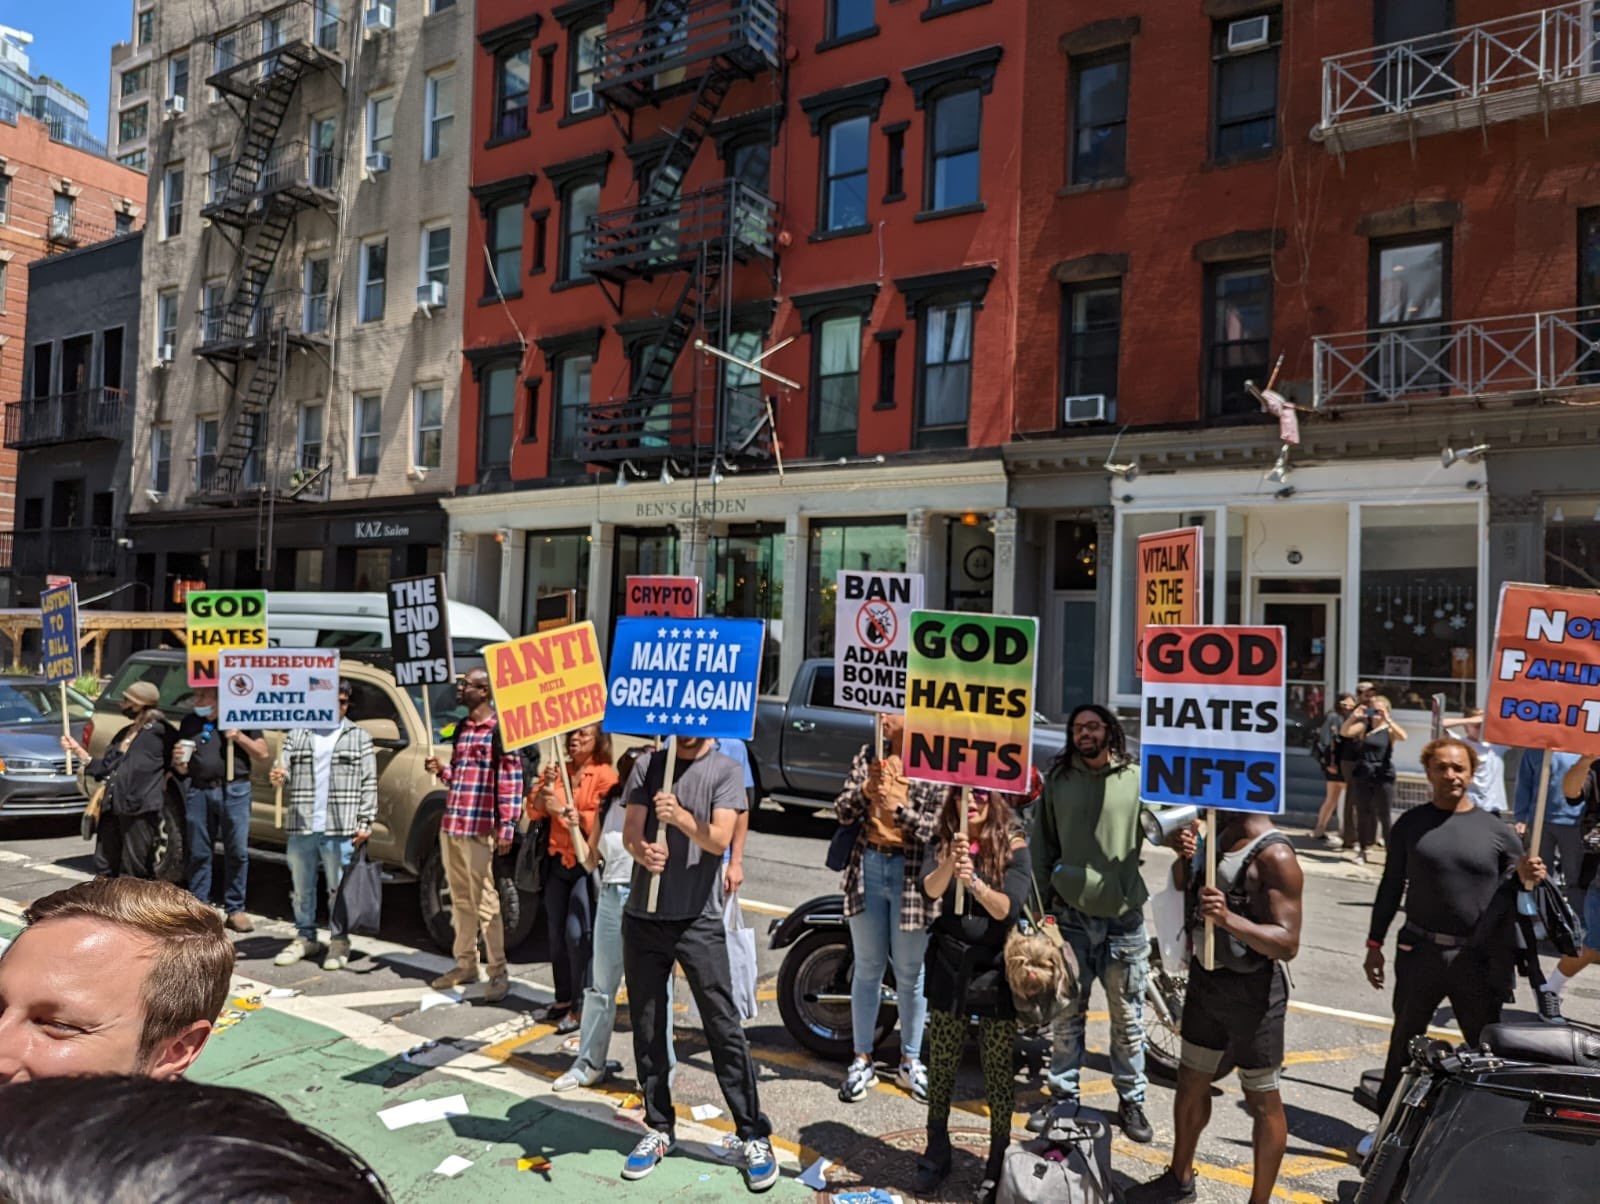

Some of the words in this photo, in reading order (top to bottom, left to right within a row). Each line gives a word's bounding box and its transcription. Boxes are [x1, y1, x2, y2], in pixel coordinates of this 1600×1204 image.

[636, 502, 677, 517] BEN'S
[681, 499, 746, 515] GARDEN
[355, 521, 382, 538] KAZ
[384, 524, 410, 537] Salon
[1143, 544, 1190, 573] VITALIK
[42, 590, 70, 614] LISTEN
[391, 578, 437, 606] THE
[631, 585, 693, 605] CRYPTO
[844, 575, 911, 603] BAN
[1146, 580, 1157, 605] IS
[1159, 578, 1184, 605] THE
[191, 596, 262, 618] GOD
[394, 605, 439, 634] END
[50, 613, 64, 633] TO
[48, 635, 69, 656] BILL
[192, 628, 264, 645] HATES
[408, 632, 430, 658] IS
[913, 620, 1029, 665] GOD
[224, 655, 335, 668] ETHEREUM
[495, 627, 594, 689] ANTI
[631, 641, 690, 672] MAKE
[695, 643, 741, 674] FIAT
[844, 646, 908, 669] ADAM
[1147, 632, 1277, 676] GOD
[47, 656, 73, 680] GATES
[271, 673, 289, 686] IS
[396, 659, 448, 685] NFTS
[255, 691, 305, 704] ANTI
[610, 676, 678, 708] GREAT
[680, 679, 752, 712] AGAIN
[911, 679, 1027, 718] HATES
[225, 709, 333, 722] AMERICAN
[501, 682, 605, 744] MASKER
[1146, 696, 1279, 734] HATES
[1500, 697, 1560, 723] FOR
[909, 732, 1022, 781] NFTS
[1146, 754, 1276, 803] NFTS
